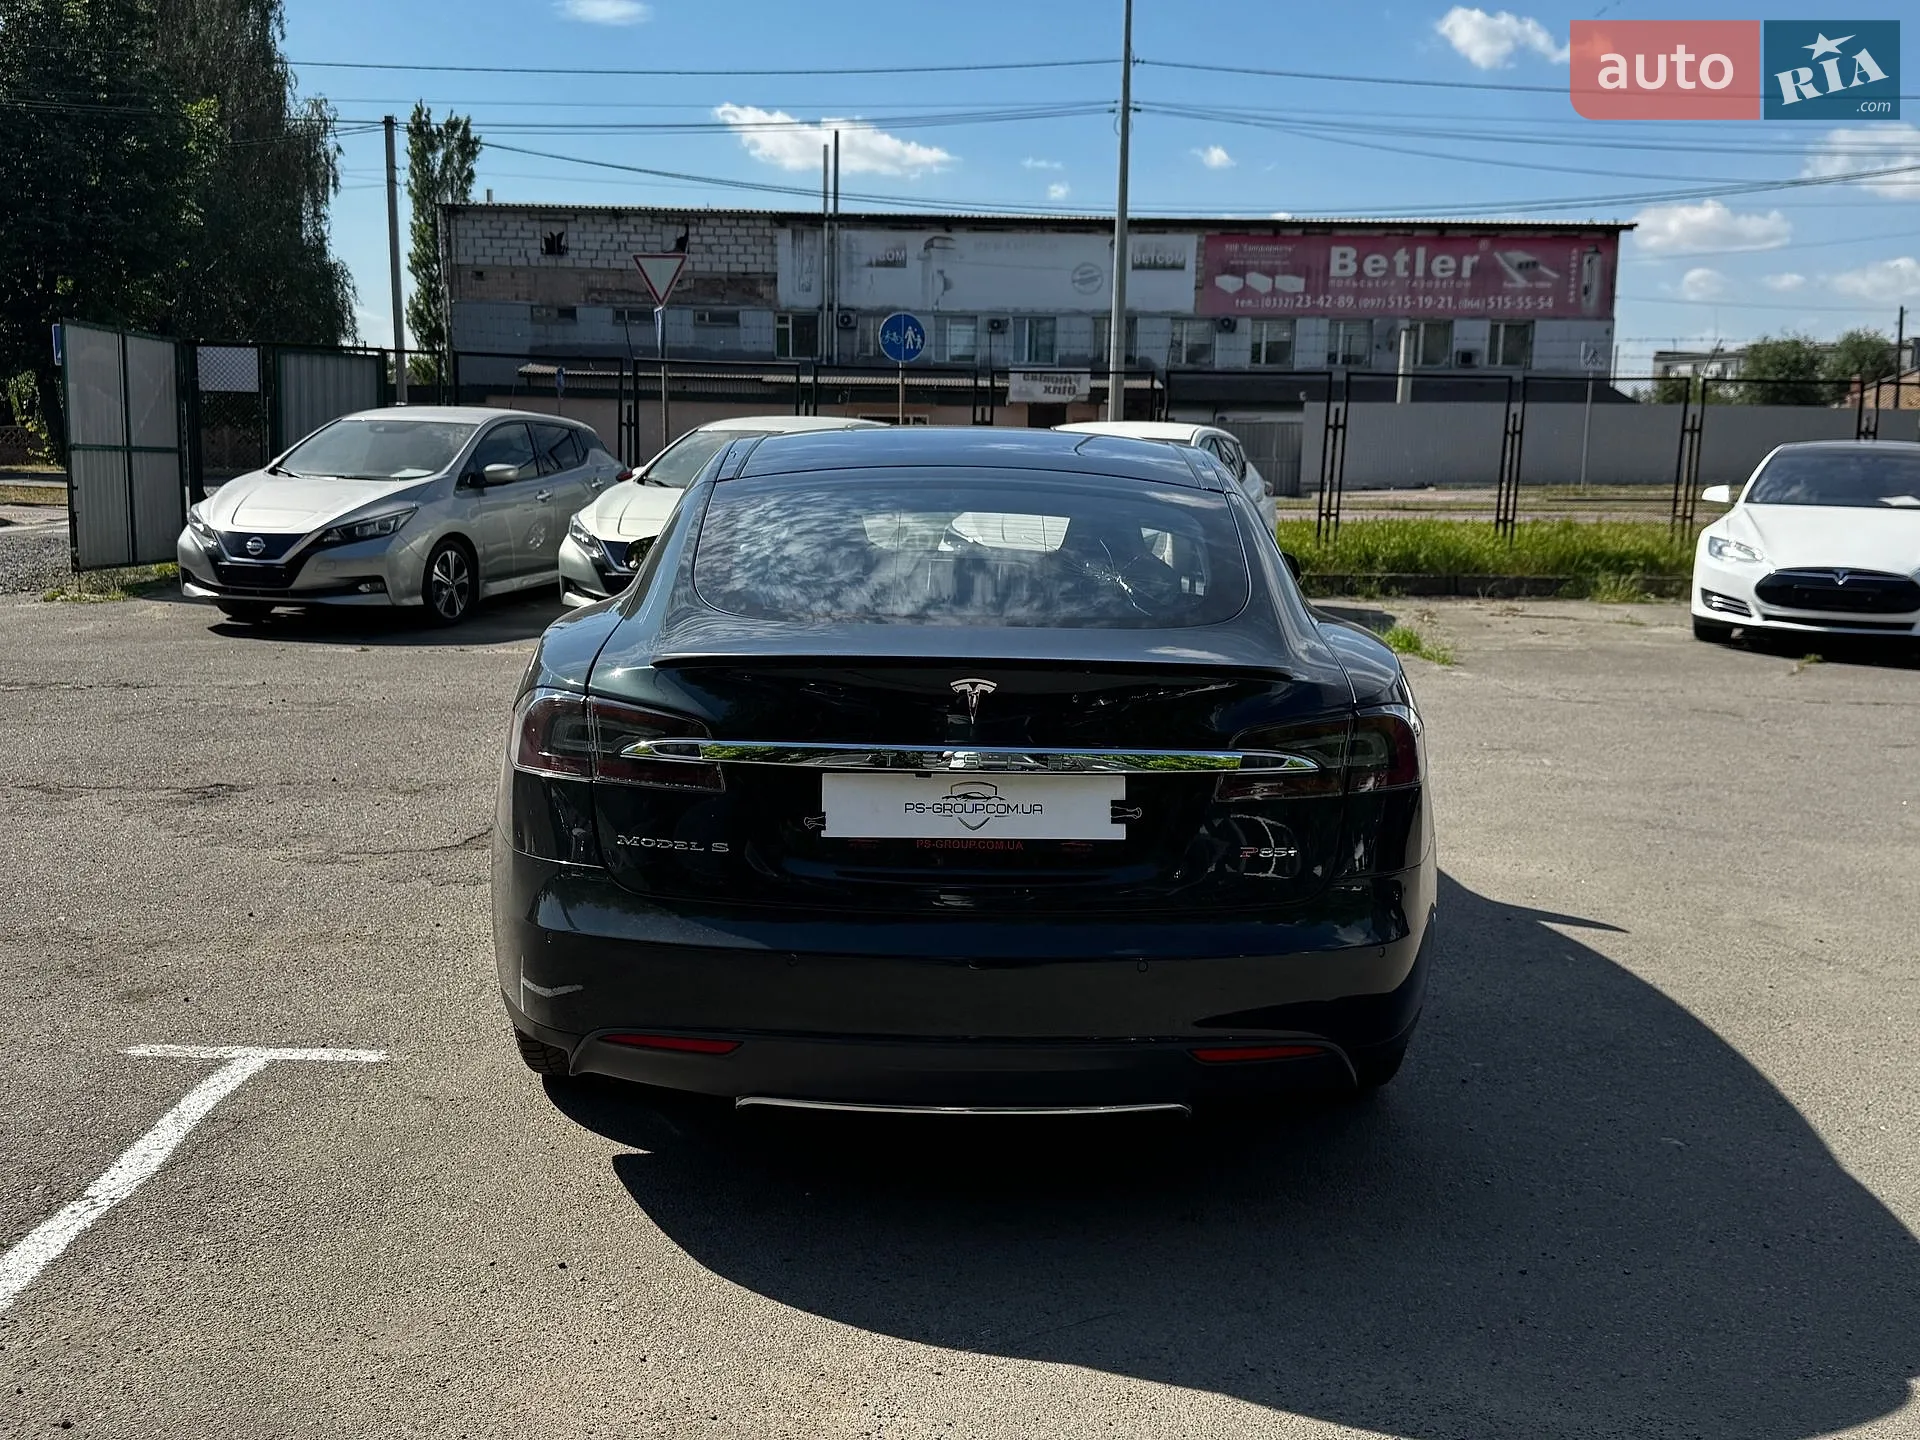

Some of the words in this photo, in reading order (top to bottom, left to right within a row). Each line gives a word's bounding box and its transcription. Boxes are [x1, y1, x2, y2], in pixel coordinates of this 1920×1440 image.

[1329, 246, 1480, 278] Betler
[881, 752, 1063, 771] TESLA
[904, 802, 1043, 815] PS-GROUP.COM.UA
[616, 834, 705, 851] MODEL
[711, 842, 730, 853] S
[916, 839, 1024, 850] PS-GROUP.COM.UA
[1239, 846, 1298, 858] P85+
